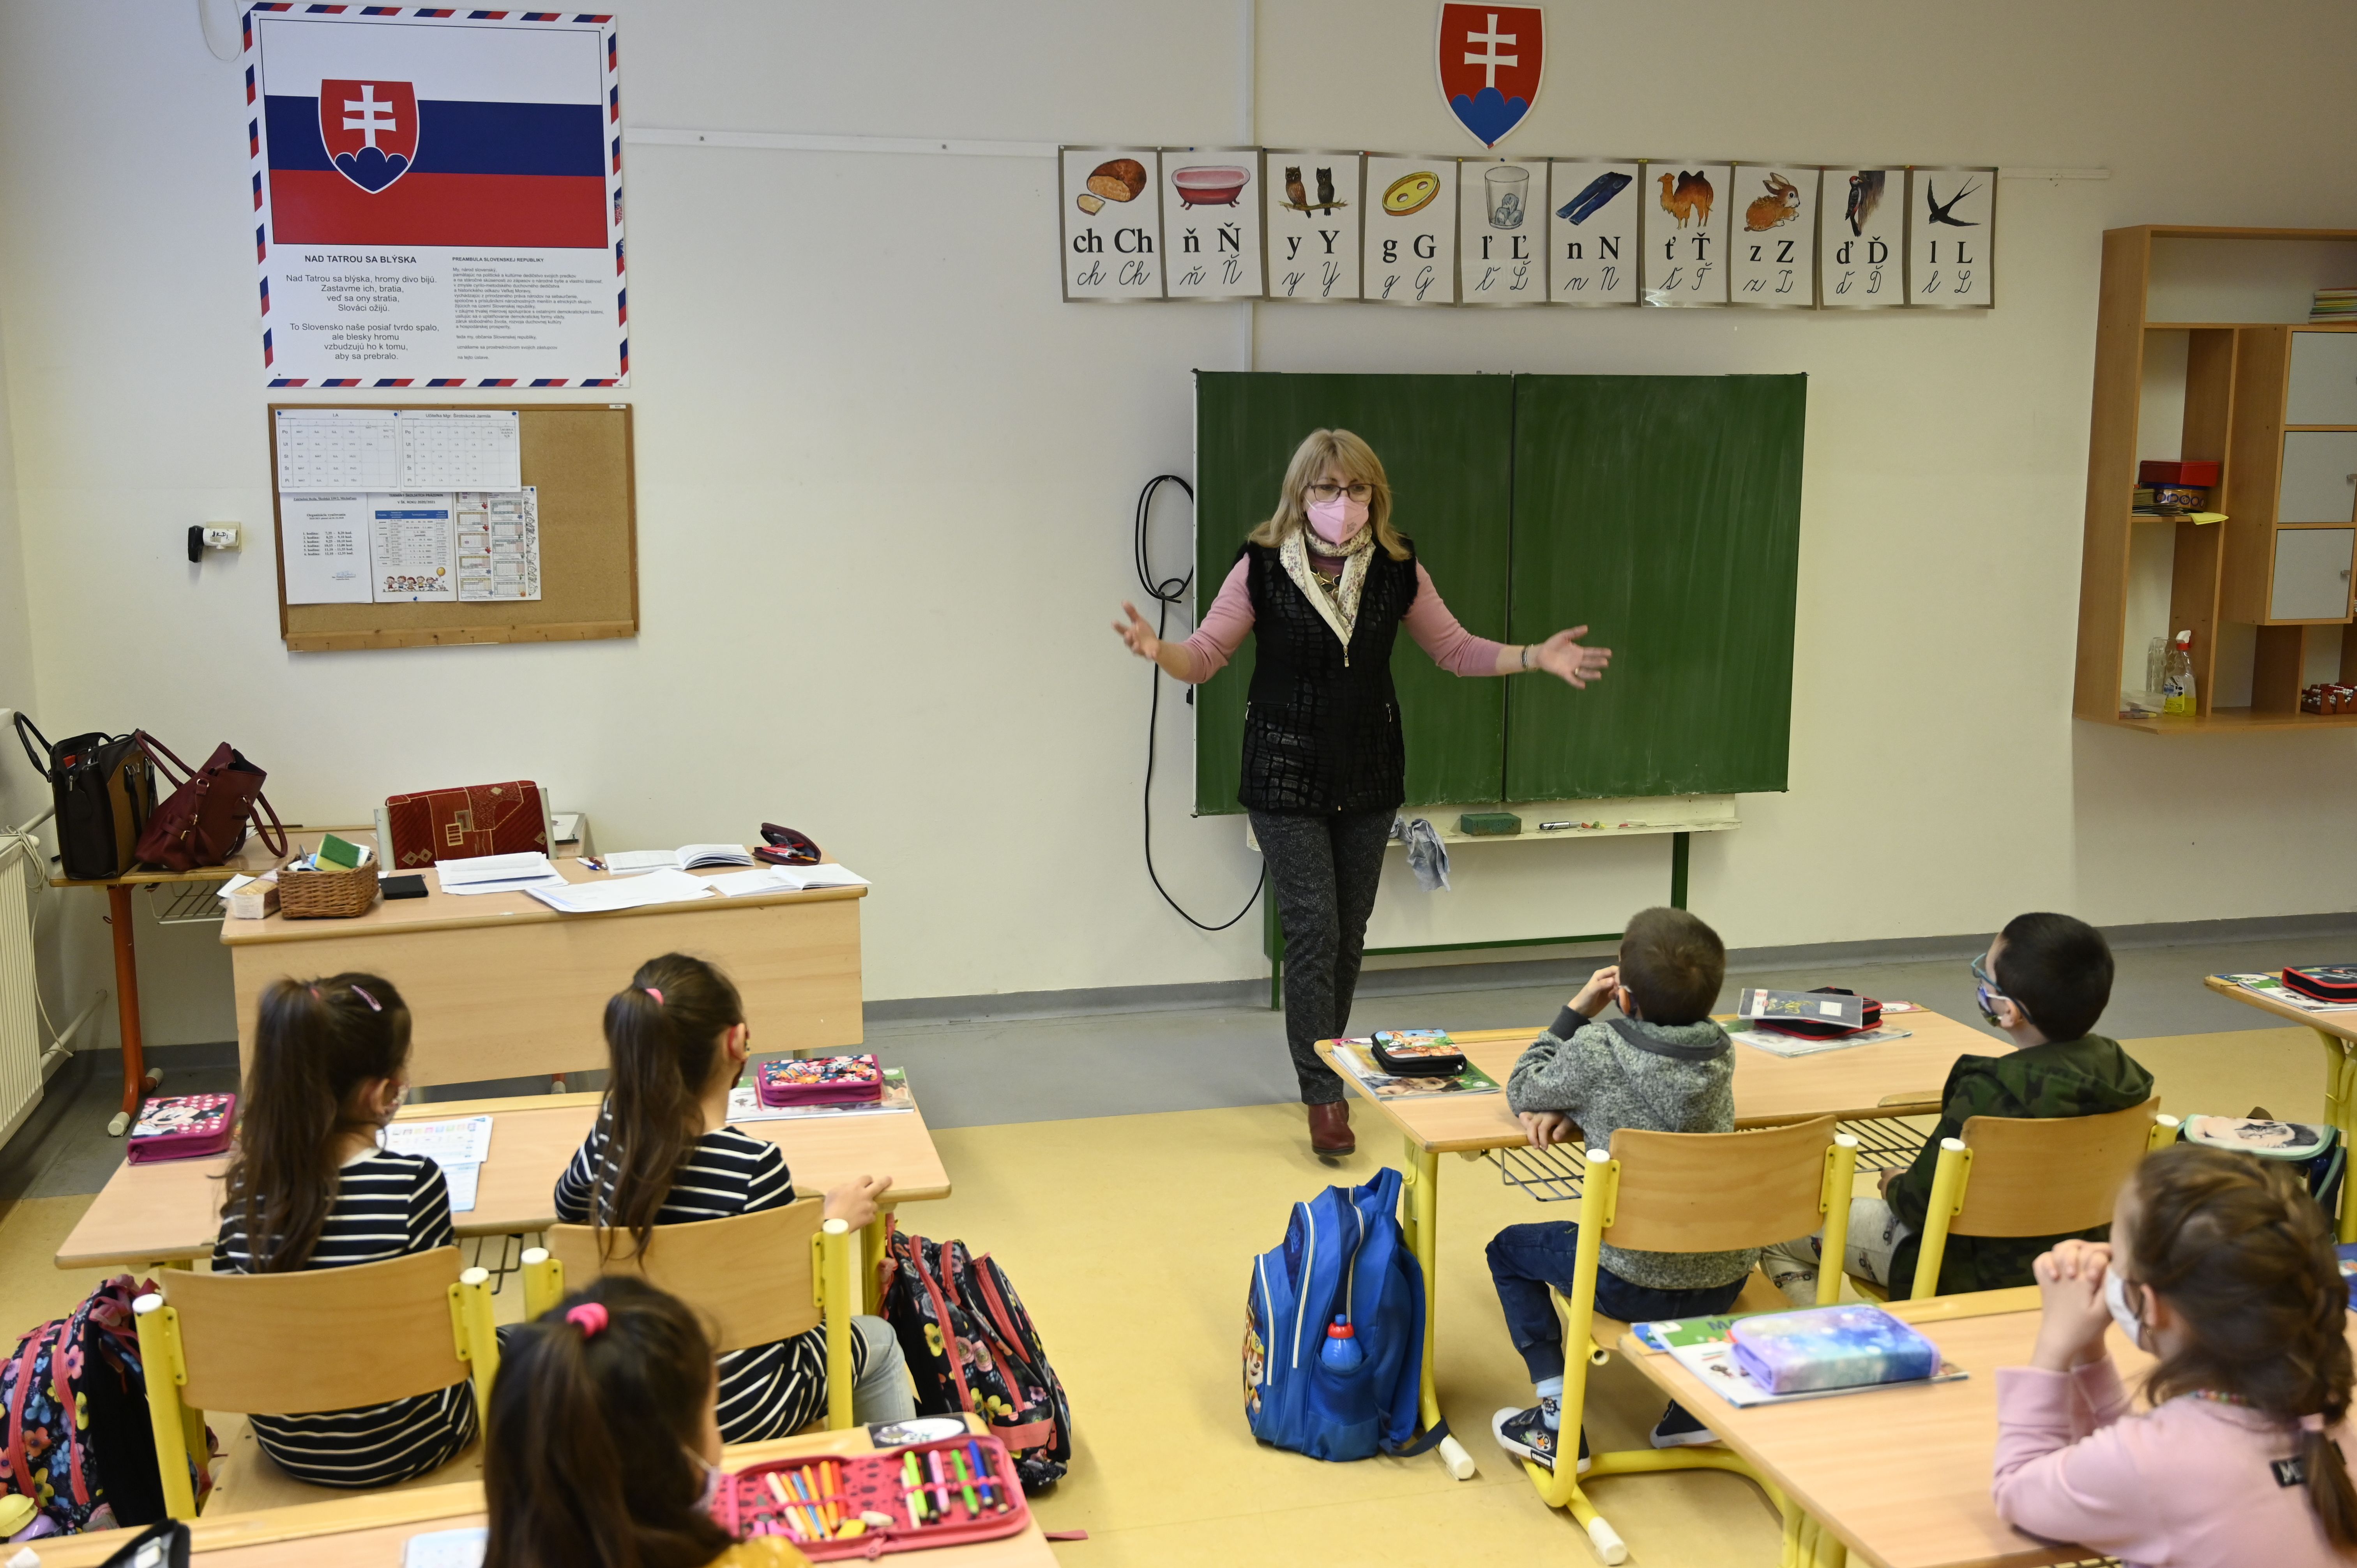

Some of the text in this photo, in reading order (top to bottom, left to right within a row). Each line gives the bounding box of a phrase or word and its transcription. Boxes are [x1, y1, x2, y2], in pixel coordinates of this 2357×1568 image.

[1074, 228, 1154, 253] ch Ch
[1183, 222, 1241, 253] ň Ň
[1287, 230, 1340, 260] y Y
[1383, 235, 1436, 263] g G
[1482, 235, 1529, 259] ľ Ľ
[1567, 237, 1620, 260] n N
[1665, 233, 1710, 260] ť Ť
[380, 254, 416, 263] BLÝSKA
[1750, 240, 1794, 263] z Z
[1837, 237, 1887, 264] ď Ď
[1930, 241, 1972, 263] l L
[345, 275, 372, 284] blýska,
[375, 275, 399, 284] hromy
[421, 276, 436, 284] bijú.
[369, 304, 389, 313] ožijú.
[346, 333, 371, 341] blesky
[416, 324, 439, 332] spalo,
[324, 343, 364, 351] vzbudzujú
[335, 353, 349, 361] aby
[364, 353, 398, 361] prebralo.
